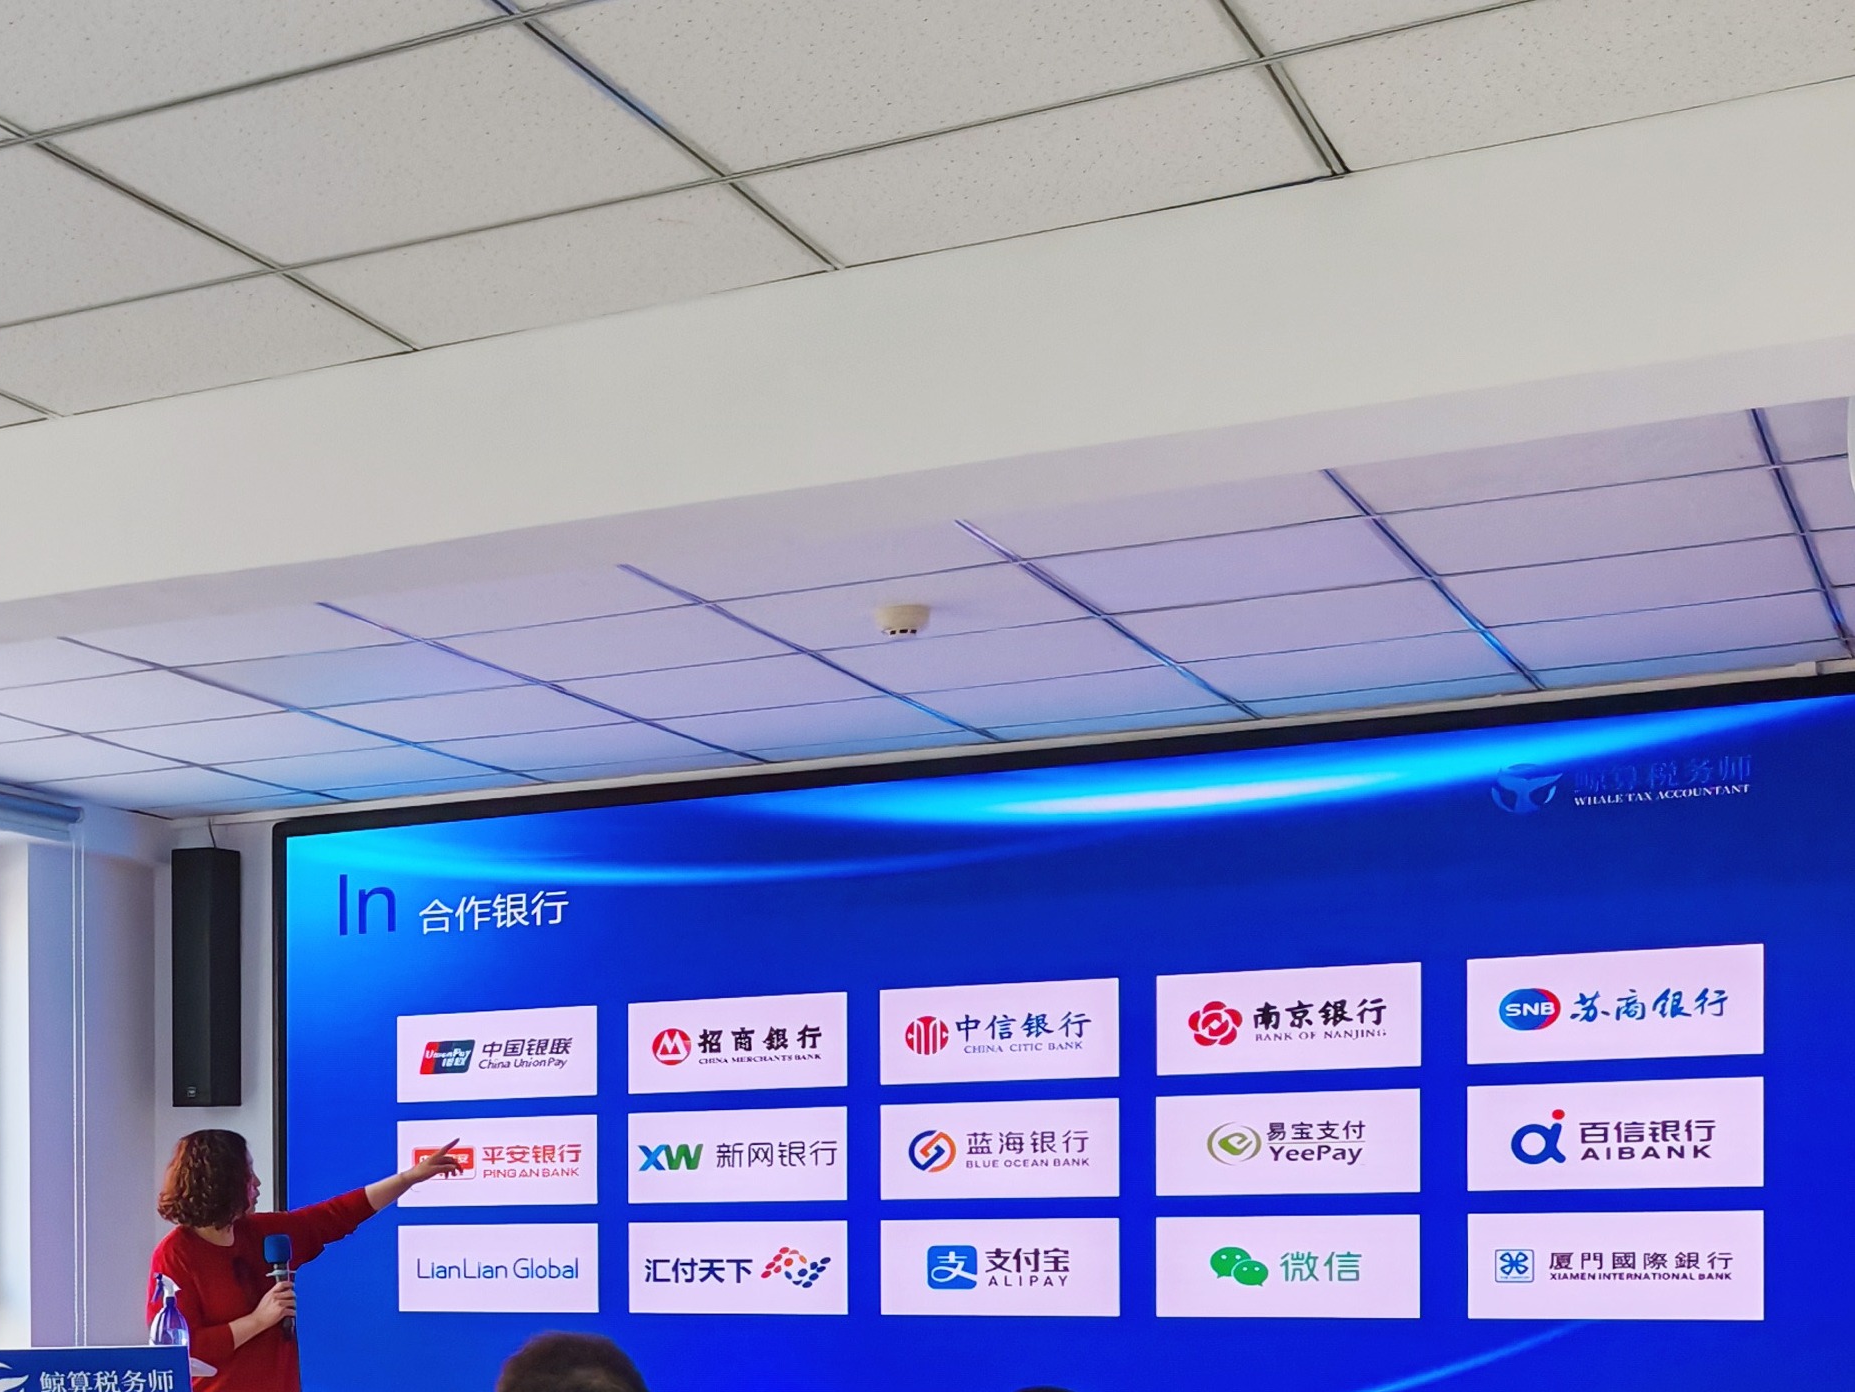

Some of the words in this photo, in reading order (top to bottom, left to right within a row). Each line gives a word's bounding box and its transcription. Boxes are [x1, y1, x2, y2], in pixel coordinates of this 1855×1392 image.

[1574, 794, 1623, 806] WHALE
[1625, 791, 1652, 803] TAX
[1655, 784, 1750, 800] ACCOUNTANT
[418, 890, 569, 935] 合作银行
[1253, 998, 1387, 1030] 南京银行
[1505, 1001, 1556, 1018] SNB
[1569, 987, 1729, 1023] 苏商银行
[955, 1011, 1092, 1042] 中信银行
[1255, 1032, 1293, 1042] BANK
[1298, 1031, 1317, 1041] OF
[1323, 1028, 1387, 1040] NANJING
[482, 1037, 573, 1058] 中国银联
[697, 1024, 822, 1053] 招商銀行
[963, 1044, 1004, 1054] CHINA
[1009, 1042, 1043, 1052] CITIC
[1048, 1041, 1083, 1051] BANK
[478, 1059, 510, 1070] China
[698, 1057, 729, 1065] CHINA
[731, 1055, 793, 1063] MERCHANTS
[794, 1053, 822, 1061] BANK
[1267, 1120, 1366, 1141] 易宝支付
[1579, 1119, 1716, 1143] 百信银行
[966, 1130, 1090, 1155] 蓝海银行
[1581, 1145, 1712, 1161] AIBANK
[482, 1144, 582, 1164] 平安银行
[638, 1144, 703, 1171] XW
[716, 1141, 838, 1168] 新网银行
[966, 1159, 999, 1169] BLUE
[1004, 1158, 1049, 1168] OCEAN
[1053, 1157, 1090, 1167] BANK
[1269, 1145, 1363, 1165] YeePay
[417, 1257, 509, 1280] LianLian
[513, 1257, 579, 1280] Global
[644, 1257, 753, 1283] 汇付天下
[984, 1247, 1069, 1273] 支付宝
[1279, 1251, 1362, 1283] 微信
[988, 1275, 1069, 1287] ALIPAY
[1549, 1272, 1595, 1281] XIAMEN
[1598, 1272, 1695, 1281] INTERNATIONAL
[1698, 1272, 1732, 1281] BANK
